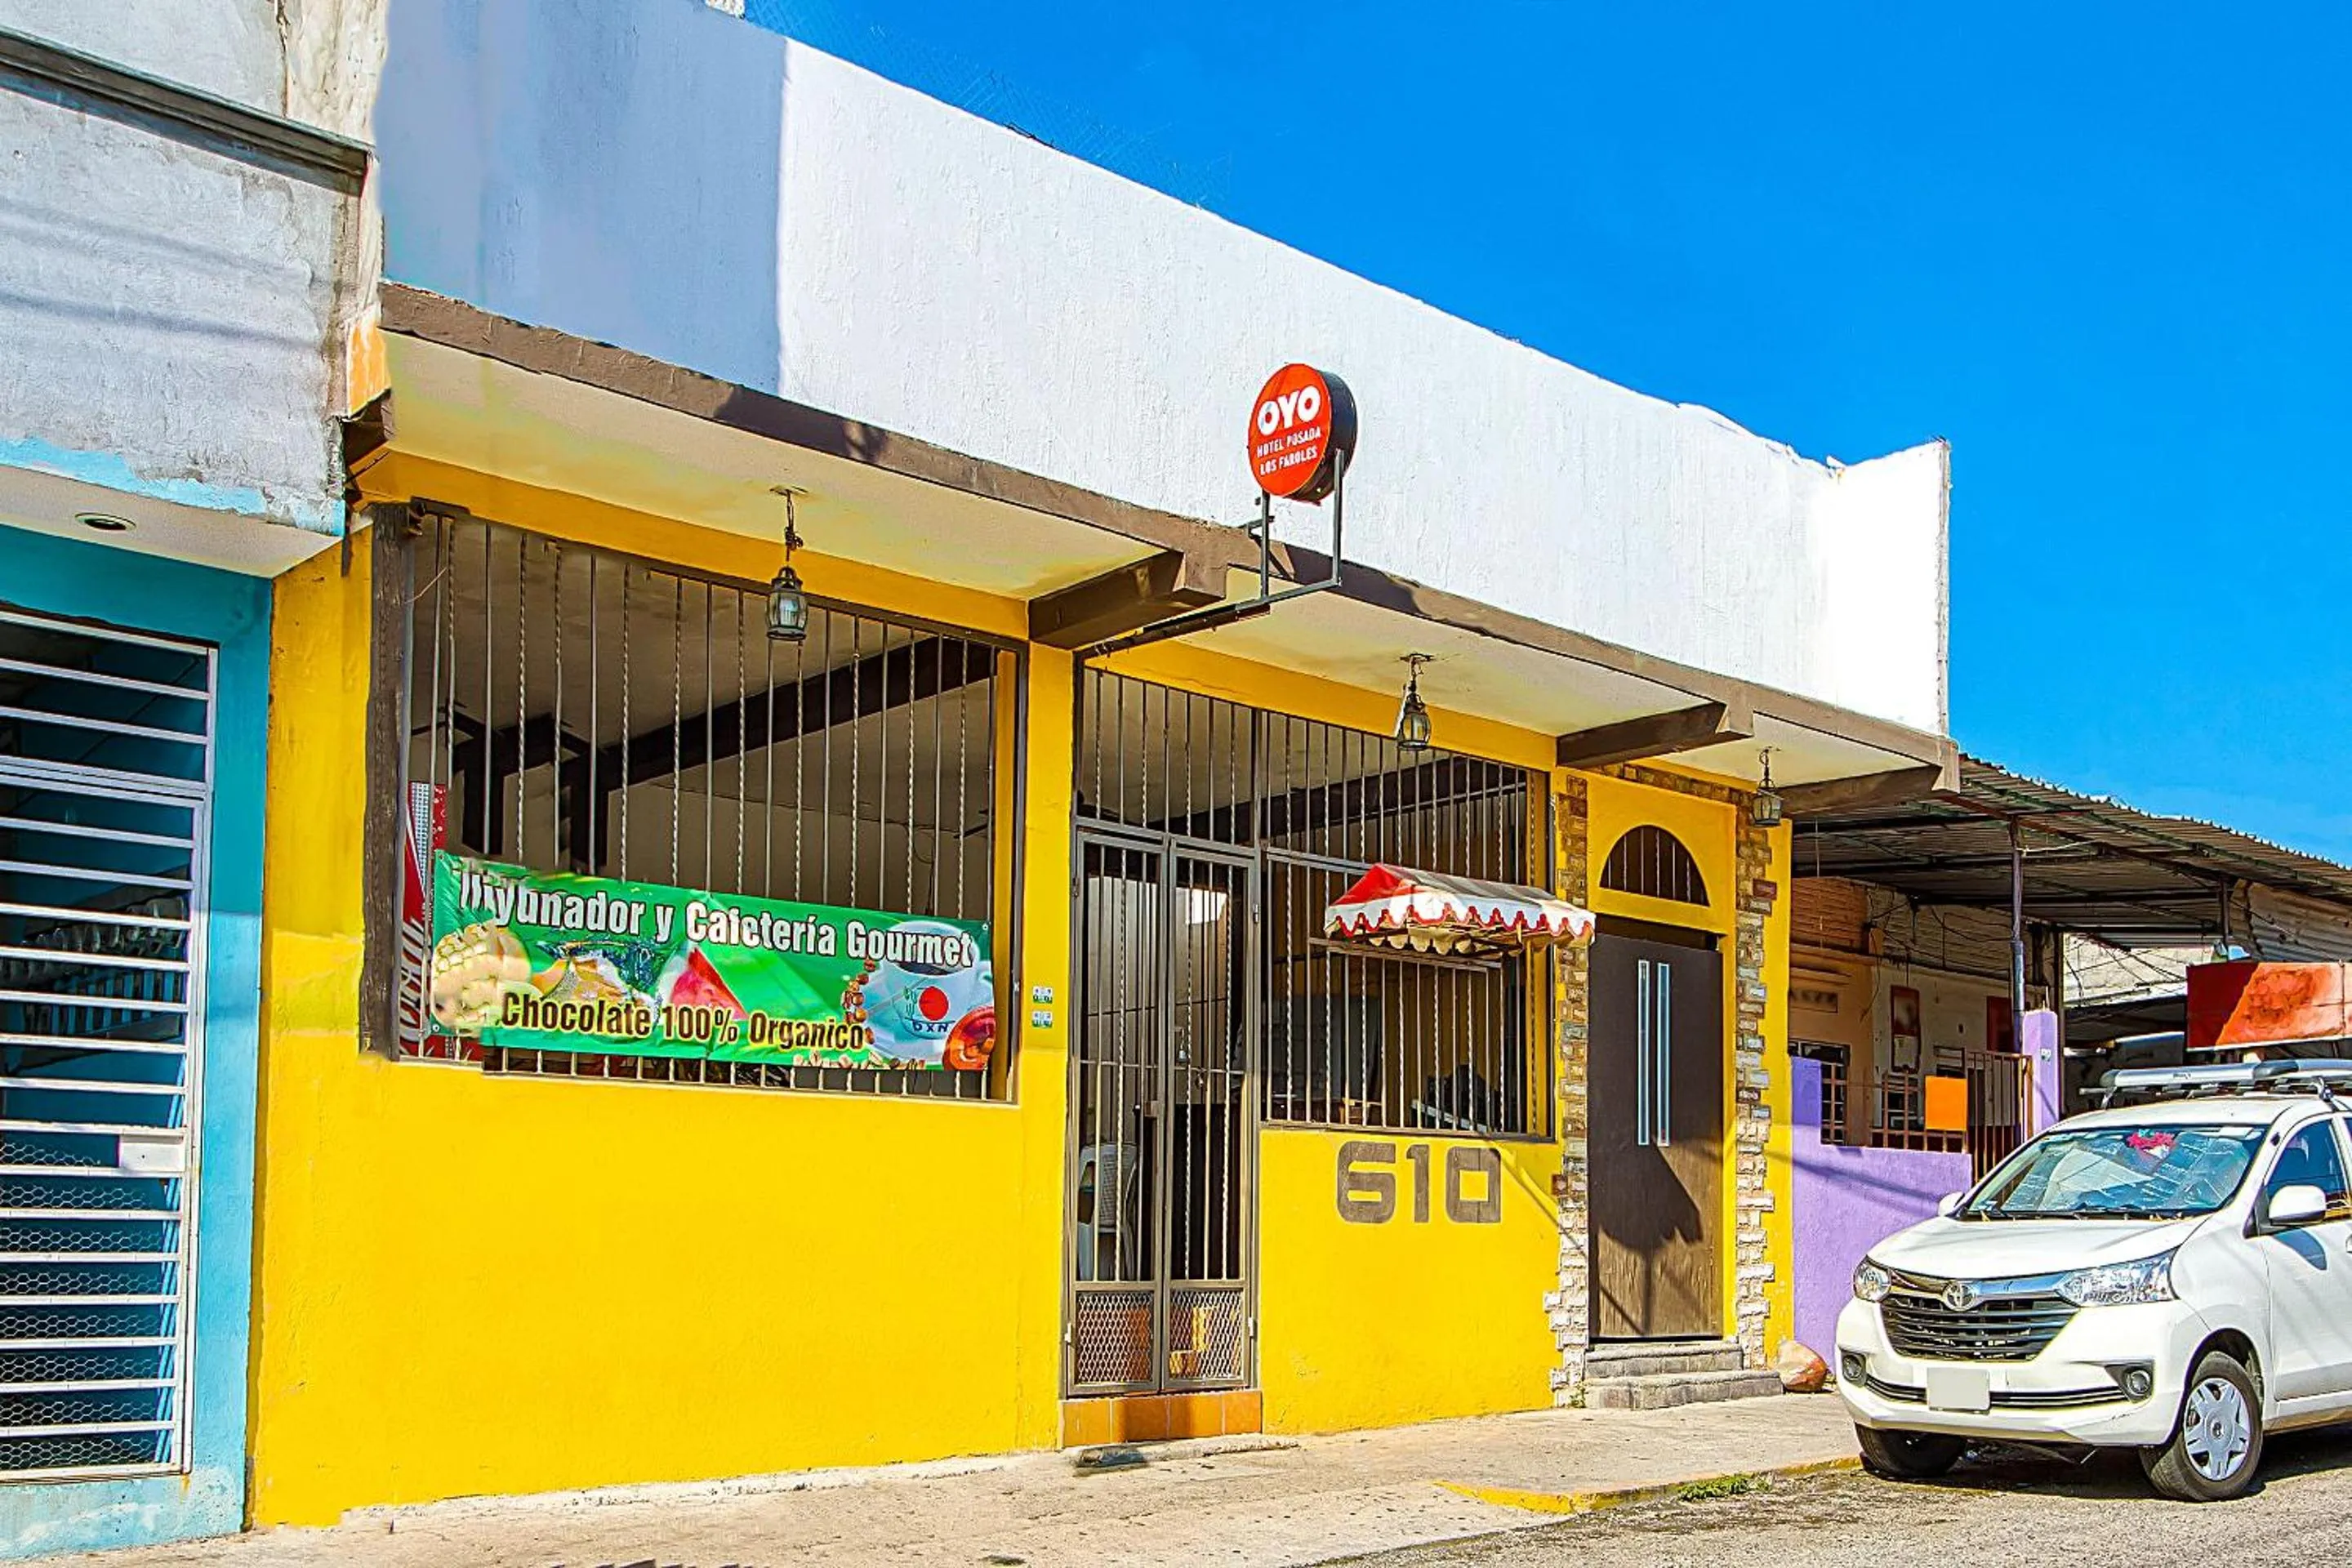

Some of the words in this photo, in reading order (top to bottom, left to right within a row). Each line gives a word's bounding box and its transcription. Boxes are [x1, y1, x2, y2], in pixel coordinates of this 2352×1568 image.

[1257, 385, 1321, 436] OYO
[1258, 439, 1285, 458] HOTEL
[1286, 426, 1321, 448] POSADA
[1260, 459, 1277, 475] LOS
[1279, 445, 1317, 470] FAROLES
[655, 904, 675, 943] y
[847, 920, 973, 968] Gourmet
[501, 991, 652, 1038] Chocolate
[662, 1005, 738, 1043] 100%
[749, 1011, 865, 1050] Organico
[1336, 1140, 1502, 1224] 610
